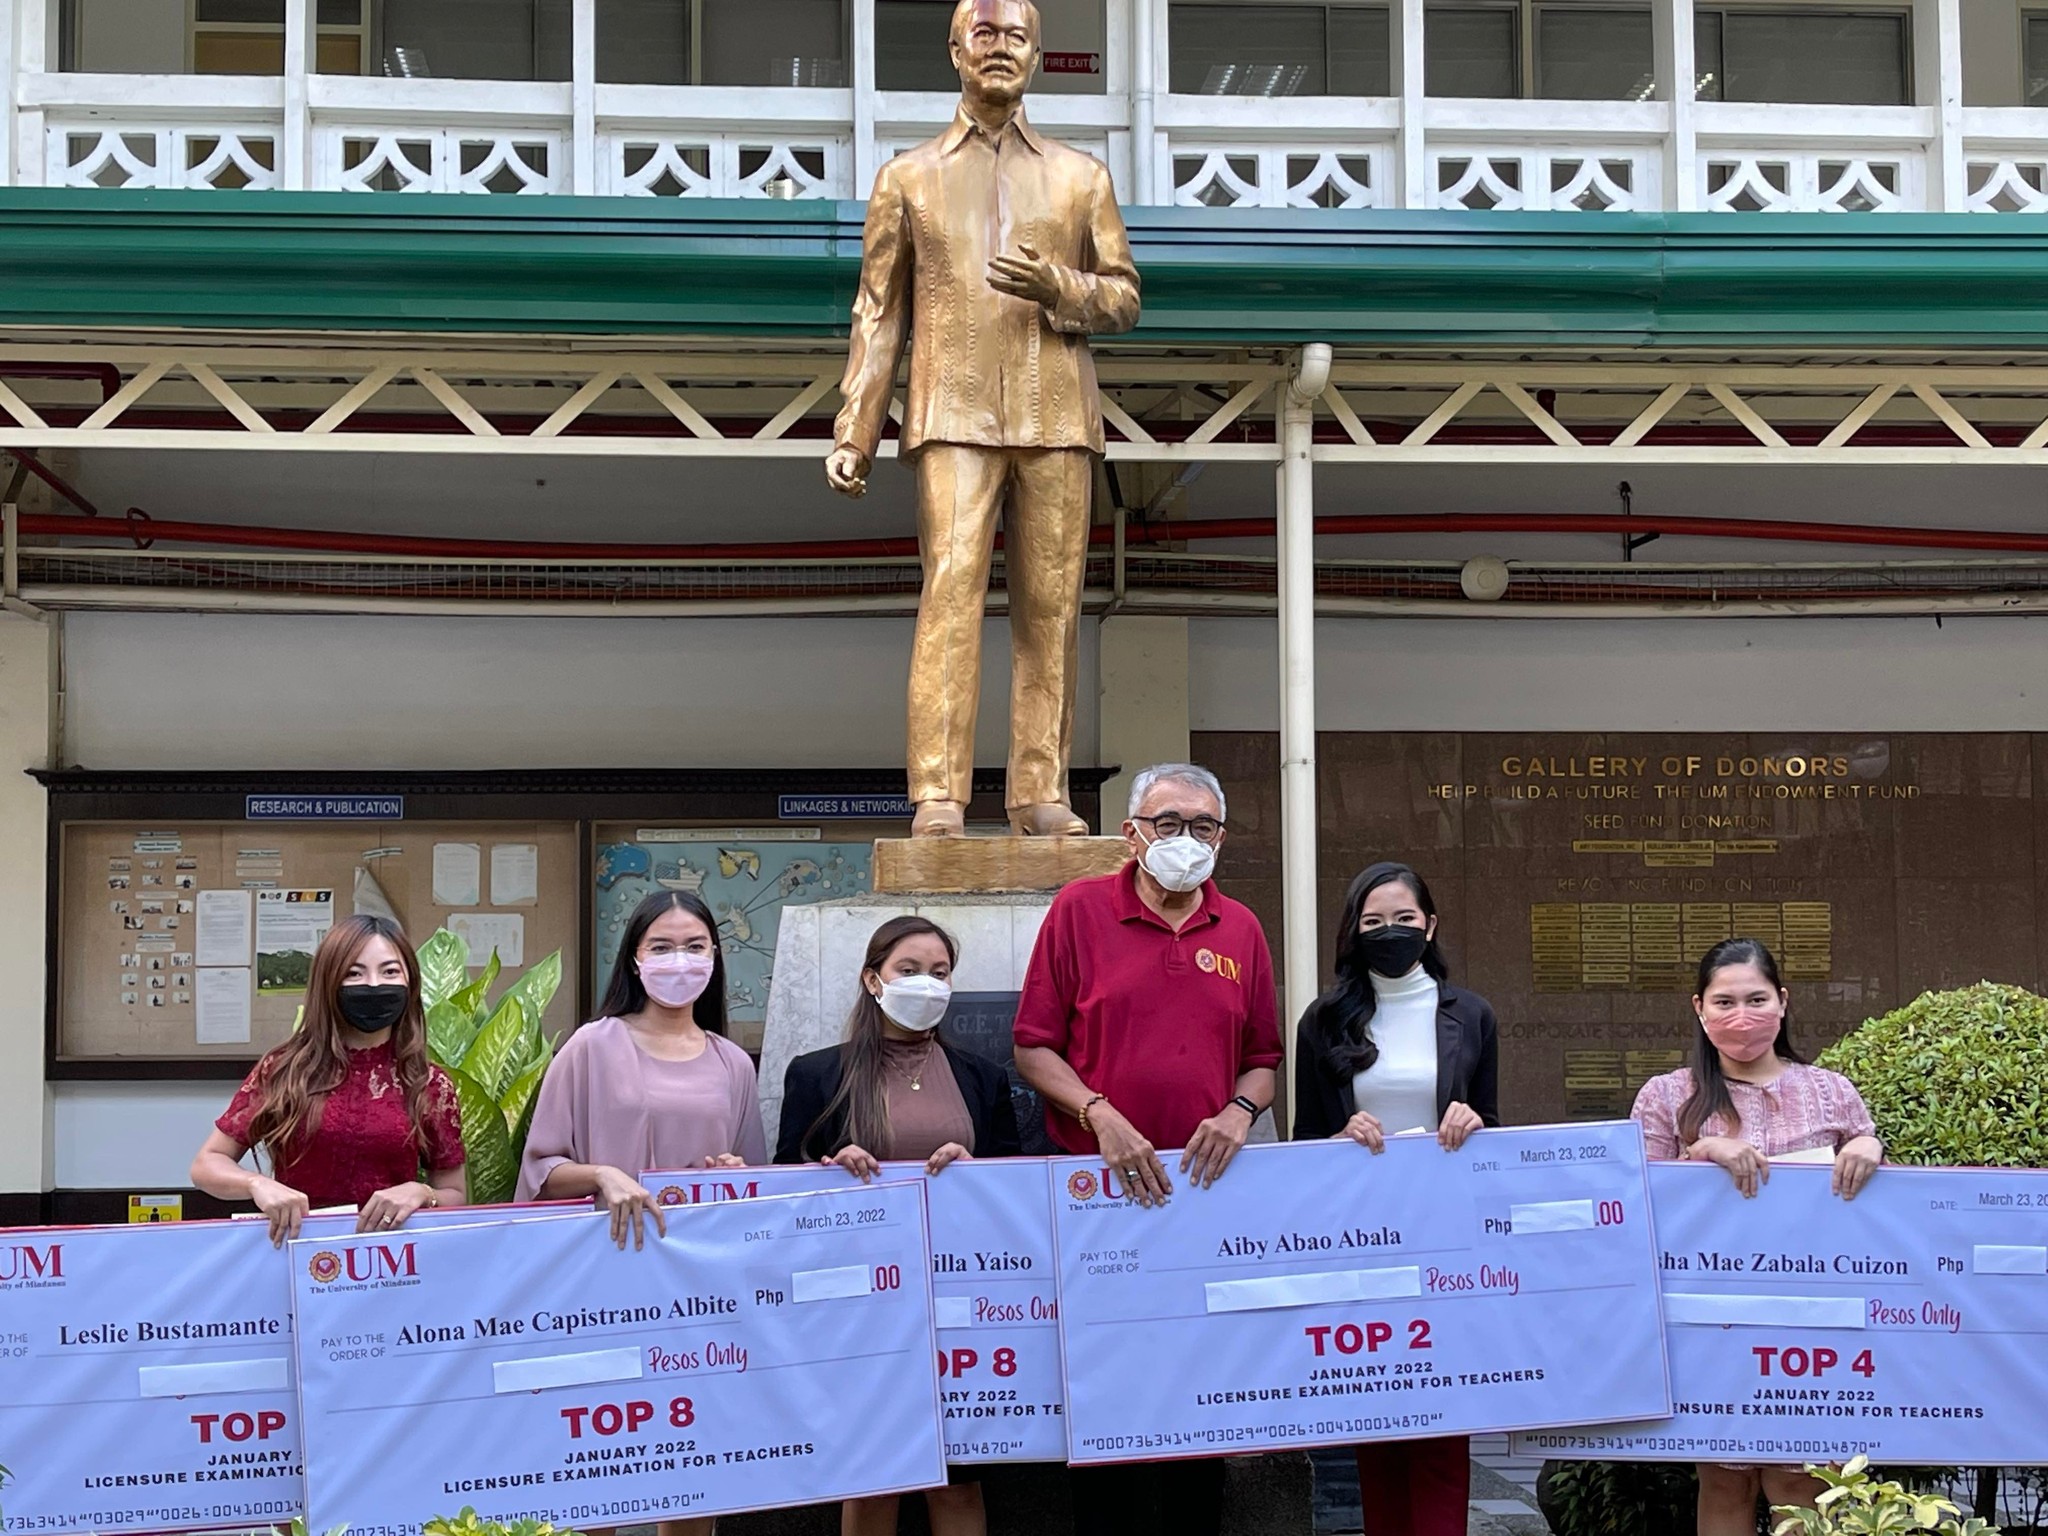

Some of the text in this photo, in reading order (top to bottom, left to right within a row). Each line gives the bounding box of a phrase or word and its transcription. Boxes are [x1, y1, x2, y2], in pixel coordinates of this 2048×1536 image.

[1044, 57, 1089, 68] FIRE EXIT
[1501, 756, 1850, 777] GALLERY OF DONORS
[1427, 785, 1478, 800] HELP
[1546, 785, 1559, 799] A
[1654, 784, 1692, 800] THE
[1700, 784, 1728, 799] UM
[1735, 785, 1861, 800] ENDOWMENT
[1867, 786, 1921, 800] FUND
[250, 800, 400, 815] RESEARCH & PUBLICATION
[783, 800, 915, 814] LINKAGES & NETWORKIN
[1583, 814, 1624, 829] SEED
[1680, 814, 1772, 830] DONATION
[1215, 953, 1242, 985] UM
[1520, 1145, 1607, 1164] March 23, 2022
[1978, 1193, 2048, 1208] March 23, 20
[796, 1208, 886, 1231] March 23, 2022
[1484, 1200, 1624, 1236] Php .00
[1217, 1226, 1402, 1260] Aiby Abao Abala
[342, 1242, 420, 1281] UM
[933, 1251, 1033, 1273] illa Yaiso
[1080, 1249, 1139, 1262] PAY TO THE
[1697, 1252, 1744, 1272] Mae
[1751, 1252, 1826, 1274] Zabala
[1833, 1255, 1909, 1276] Cuizon
[1937, 1256, 1964, 1275] Php
[1087, 1262, 1140, 1275] ORDER OF
[309, 1286, 326, 1294] The
[327, 1283, 368, 1293] University
[755, 1264, 901, 1307] Php .00
[1425, 1264, 1520, 1296] Pesos Only
[975, 1295, 1058, 1322] Pesos Onl
[1868, 1298, 1961, 1334] Pesos Only
[59, 1323, 129, 1345] Leslie
[137, 1316, 280, 1341] Bustamante
[396, 1297, 738, 1346] Alona Mae Capistrano Albite
[8, 1333, 28, 1343] THE
[321, 1333, 385, 1349] PAY TO THE
[1305, 1319, 1433, 1357] TOP 2
[13, 1347, 28, 1358] OF
[329, 1347, 386, 1362] ORDER OF
[647, 1341, 748, 1373] Pesos Only
[992, 1347, 1017, 1377] 8
[1752, 1346, 1876, 1378] TOP 4
[1309, 1361, 1434, 1381] JANUARY 2022
[977, 1390, 1017, 1401] 2022
[1196, 1368, 1545, 1406] LICENSURE EXAMINATION FOR TEACHERS
[1753, 1389, 1876, 1402] JANUARY 2022
[560, 1396, 696, 1439] TOP 8
[1003, 1404, 1036, 1417] FOR
[1741, 1404, 1856, 1418] EXAMINATION
[1861, 1406, 1894, 1418] FOR
[1899, 1407, 1985, 1420] TEACHERS
[191, 1411, 286, 1443] TOP
[207, 1450, 292, 1466] JANUARY
[564, 1439, 697, 1465] JANUARY 2022
[84, 1464, 304, 1489] LICENSURE EXAMINATIO
[443, 1443, 815, 1494] LICENSURE EXAMINATION FOR TEACHERS
